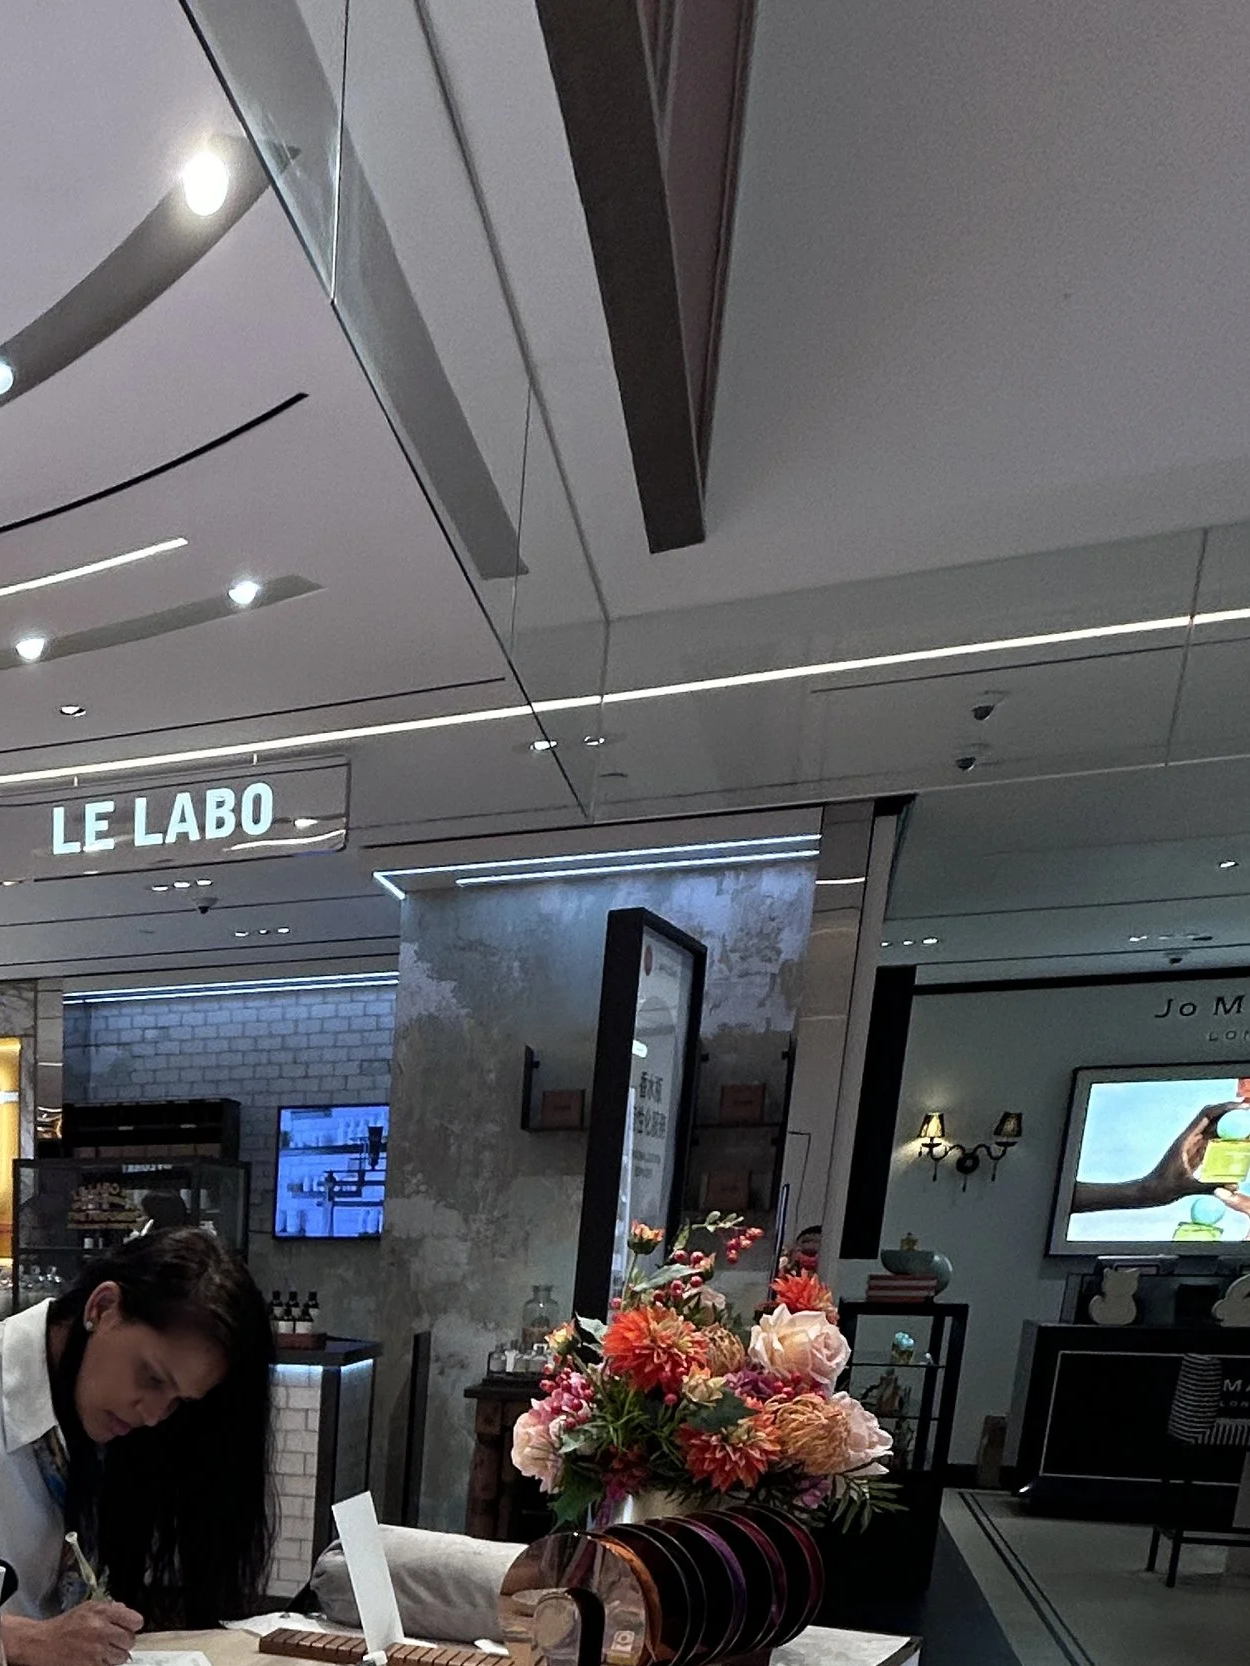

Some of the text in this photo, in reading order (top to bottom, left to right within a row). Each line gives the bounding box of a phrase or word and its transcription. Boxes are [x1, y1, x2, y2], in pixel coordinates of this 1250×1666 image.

[53, 782, 273, 855] LE LABO
[1154, 998, 1197, 1019] Jo
